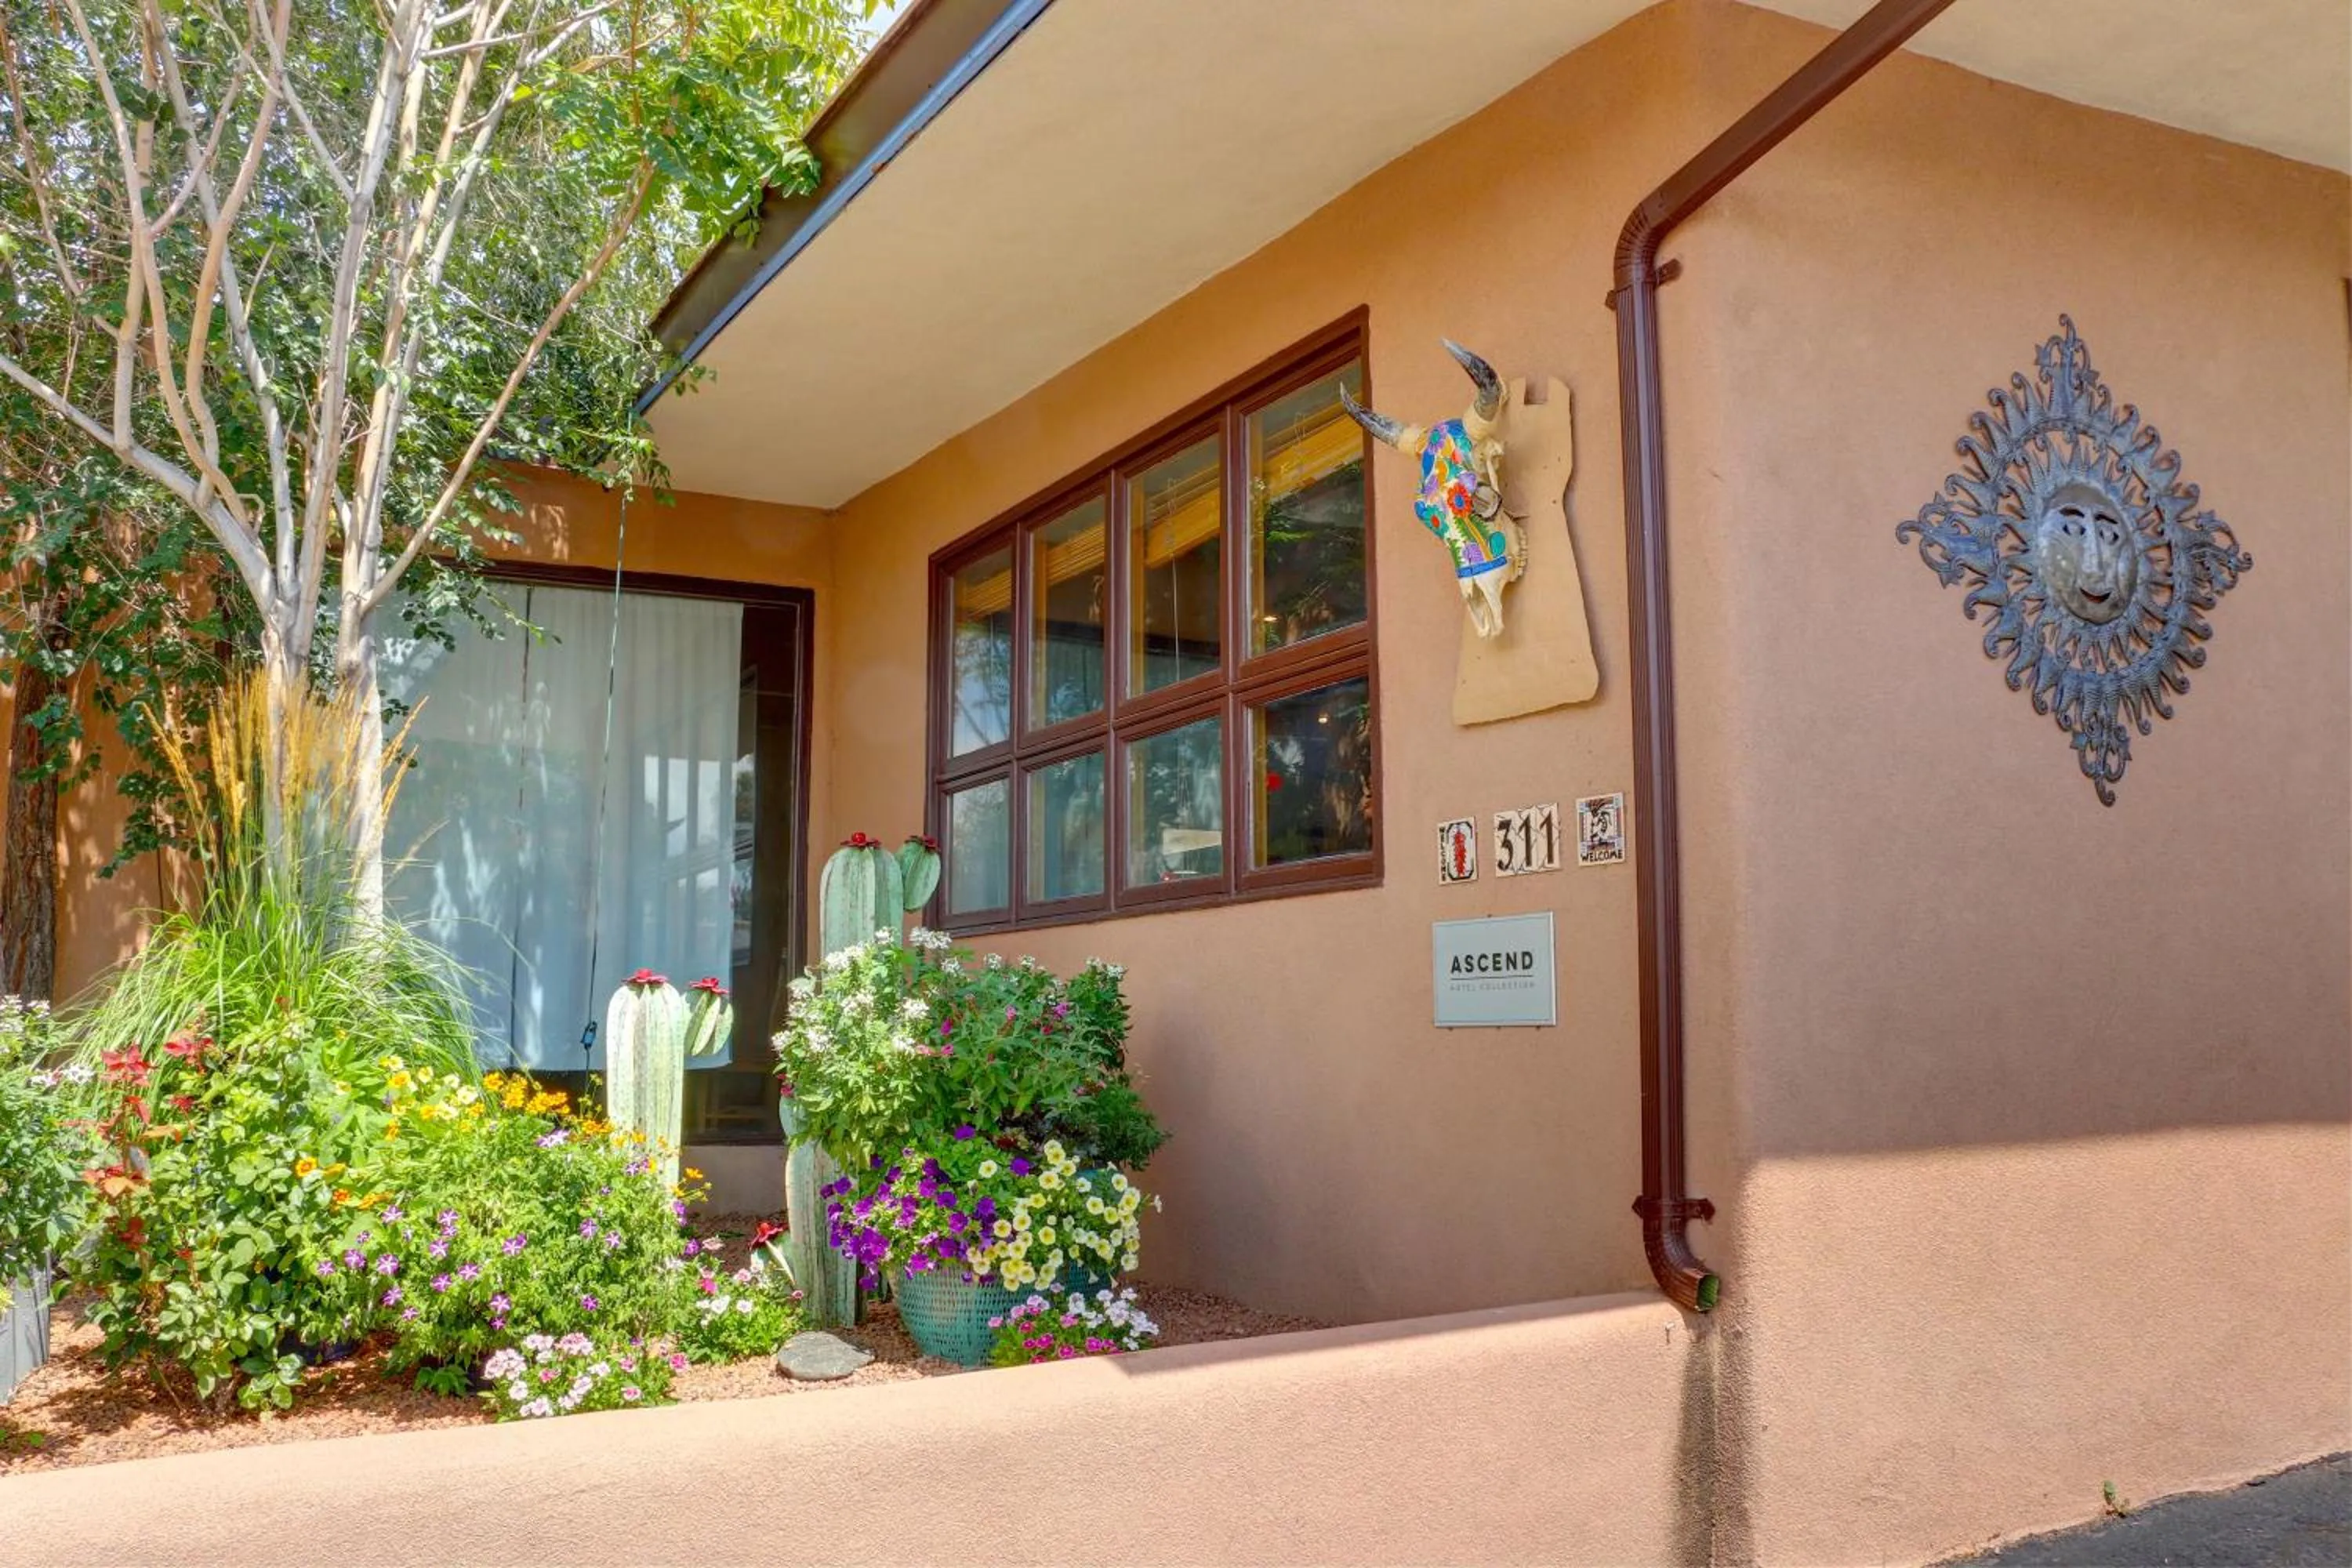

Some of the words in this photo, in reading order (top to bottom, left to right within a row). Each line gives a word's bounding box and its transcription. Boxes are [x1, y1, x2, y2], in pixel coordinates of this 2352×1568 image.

[1497, 810, 1554, 871] 311
[1581, 849, 1623, 862] WELCOME
[1450, 952, 1533, 974] ASCEND
